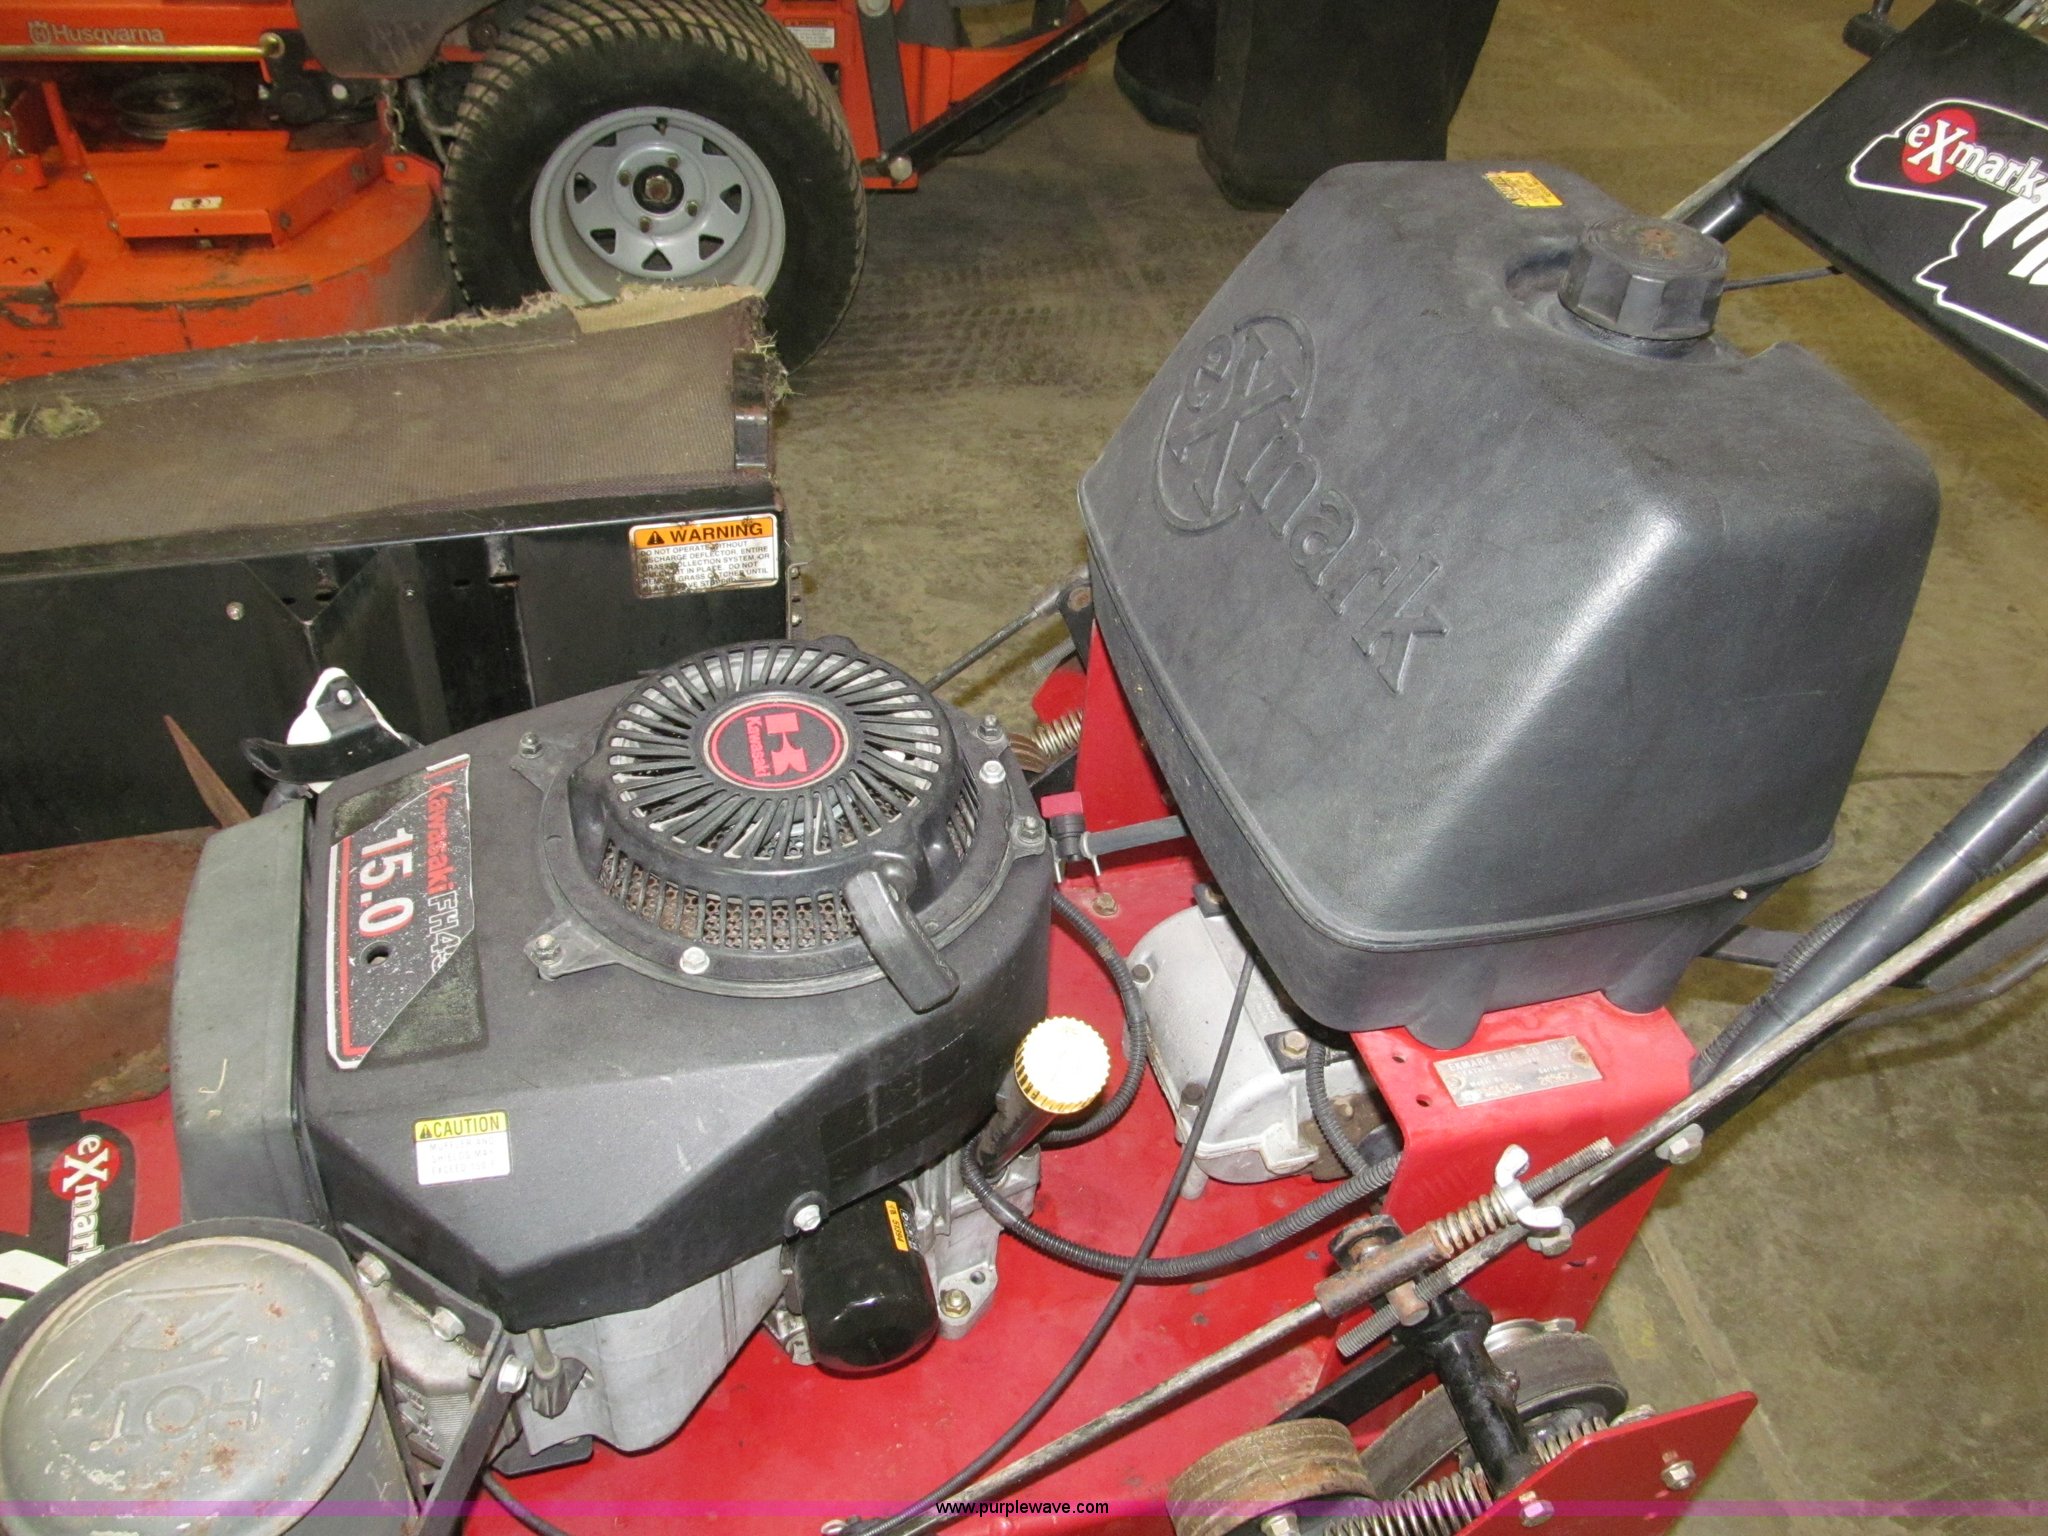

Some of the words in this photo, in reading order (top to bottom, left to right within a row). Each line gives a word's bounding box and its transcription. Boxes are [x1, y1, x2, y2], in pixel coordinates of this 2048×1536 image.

[51, 24, 166, 44] Husqvarna
[669, 523, 763, 542] WARNING
[671, 545, 709, 553] OPERATE
[708, 541, 748, 549] ITHOUT
[671, 558, 721, 568] OLLECTION
[707, 569, 744, 579] CTCHER
[426, 782, 456, 895] Kawasaki
[358, 828, 414, 937] 15.0
[433, 1115, 500, 1138] CAUTION
